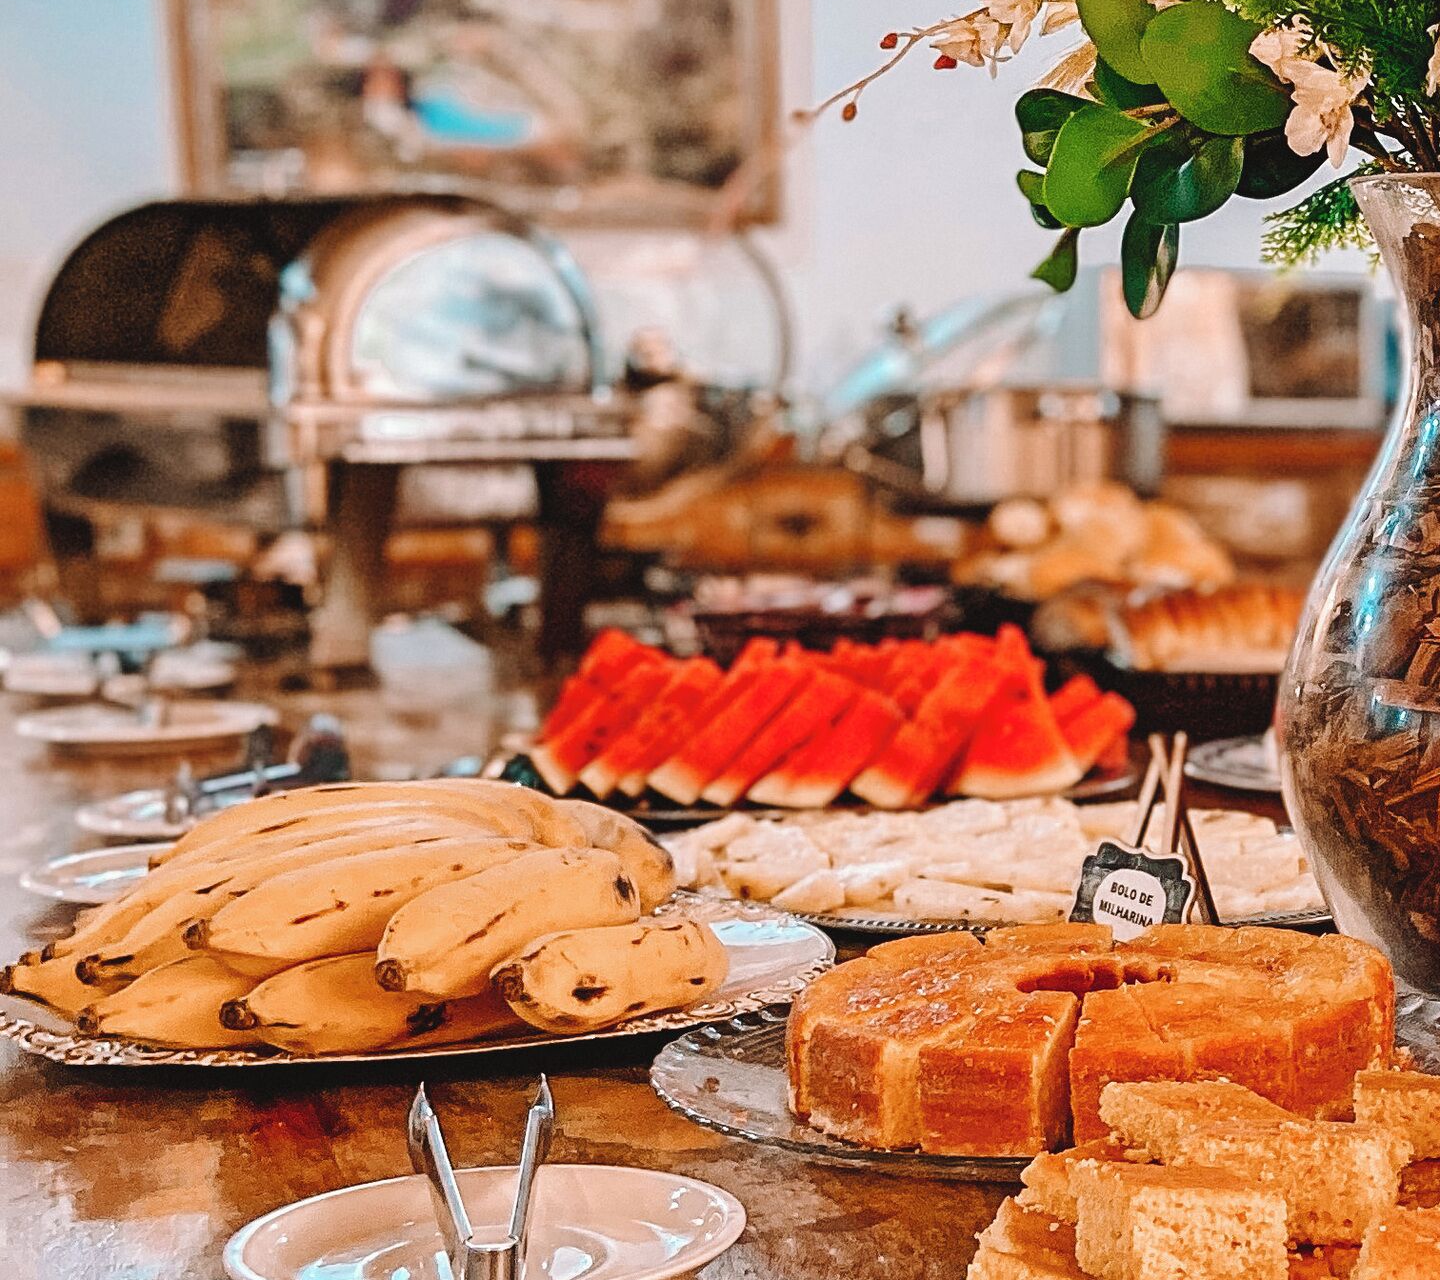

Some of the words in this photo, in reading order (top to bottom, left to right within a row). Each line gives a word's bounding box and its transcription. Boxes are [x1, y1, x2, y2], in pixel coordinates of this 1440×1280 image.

[1110, 881, 1137, 900] BOLO
[1139, 891, 1154, 906] DE
[1099, 899, 1153, 927] MILHARINA
